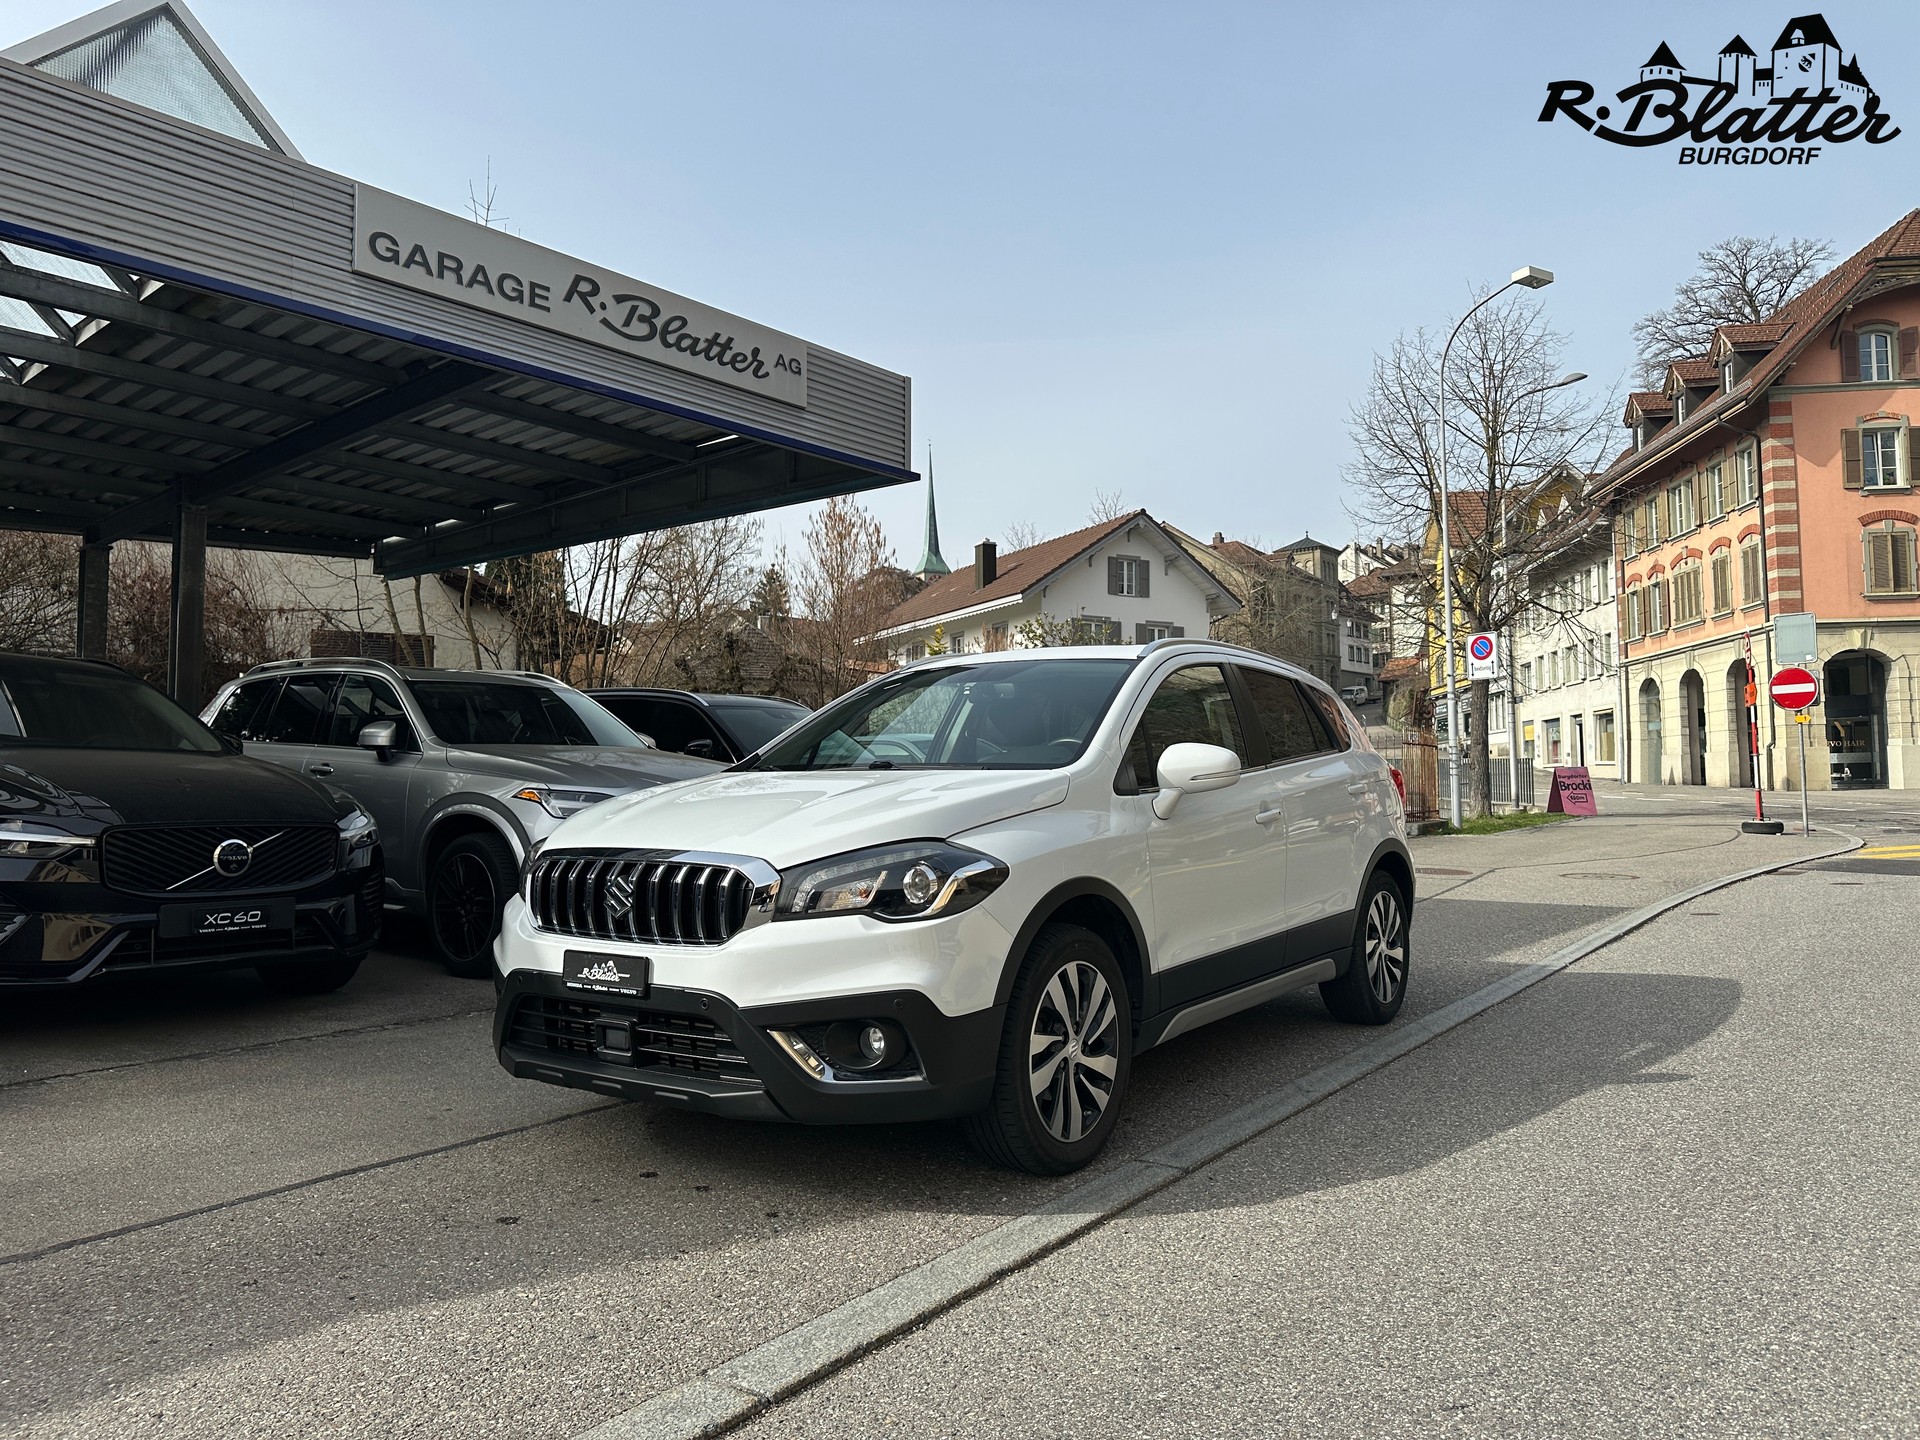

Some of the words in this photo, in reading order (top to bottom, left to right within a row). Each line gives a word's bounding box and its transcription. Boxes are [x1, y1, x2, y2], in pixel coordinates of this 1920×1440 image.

[367, 230, 552, 313] GARAGE
[774, 353, 803, 376] AG
[1559, 780, 1592, 790] Brocki
